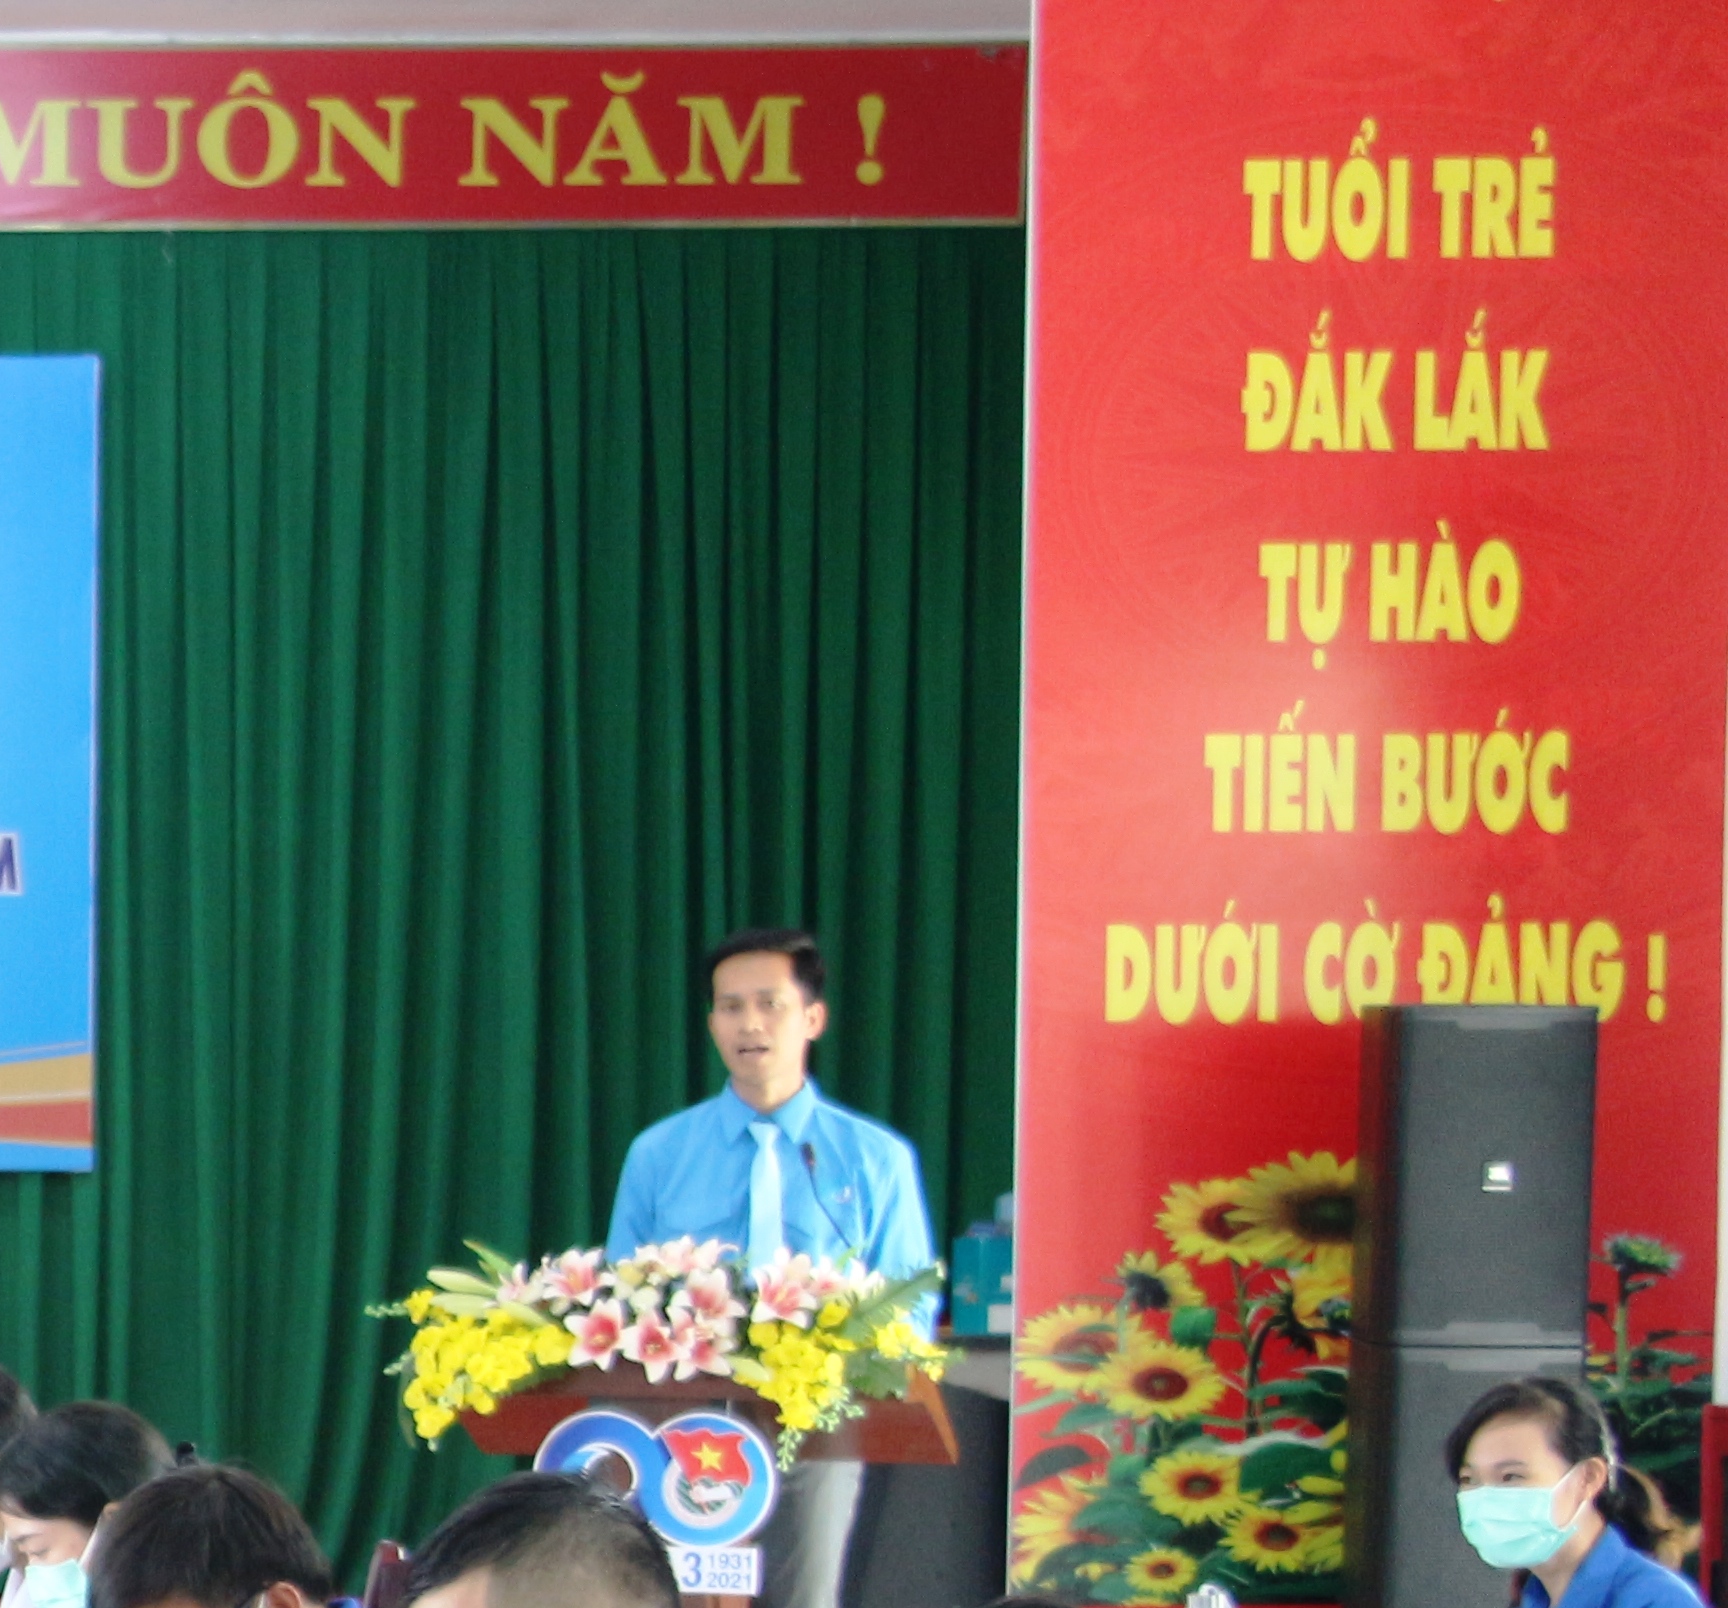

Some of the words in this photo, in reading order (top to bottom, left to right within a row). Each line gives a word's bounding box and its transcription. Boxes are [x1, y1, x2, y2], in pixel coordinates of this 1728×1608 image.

[459, 70, 805, 187] NĂM
[855, 94, 885, 187] !
[1242, 117, 1410, 262] TUỔI
[1432, 128, 1555, 259] TRẺ
[1241, 309, 1393, 452] ĐẮK
[1412, 309, 1549, 452] LẮK
[1259, 539, 1351, 670] TỰ
[1369, 519, 1521, 645] HÀO
[1204, 700, 1356, 834] TIẾN
[1380, 708, 1570, 836] BƯỚC
[1103, 899, 1279, 1026] DƯỚI
[1303, 897, 1401, 1026] CỜ
[1416, 892, 1625, 1024] ĐẢNG
[1646, 933, 1667, 1023] !
[707, 1572, 752, 1589] 2021
[708, 1554, 752, 1569] 1931
